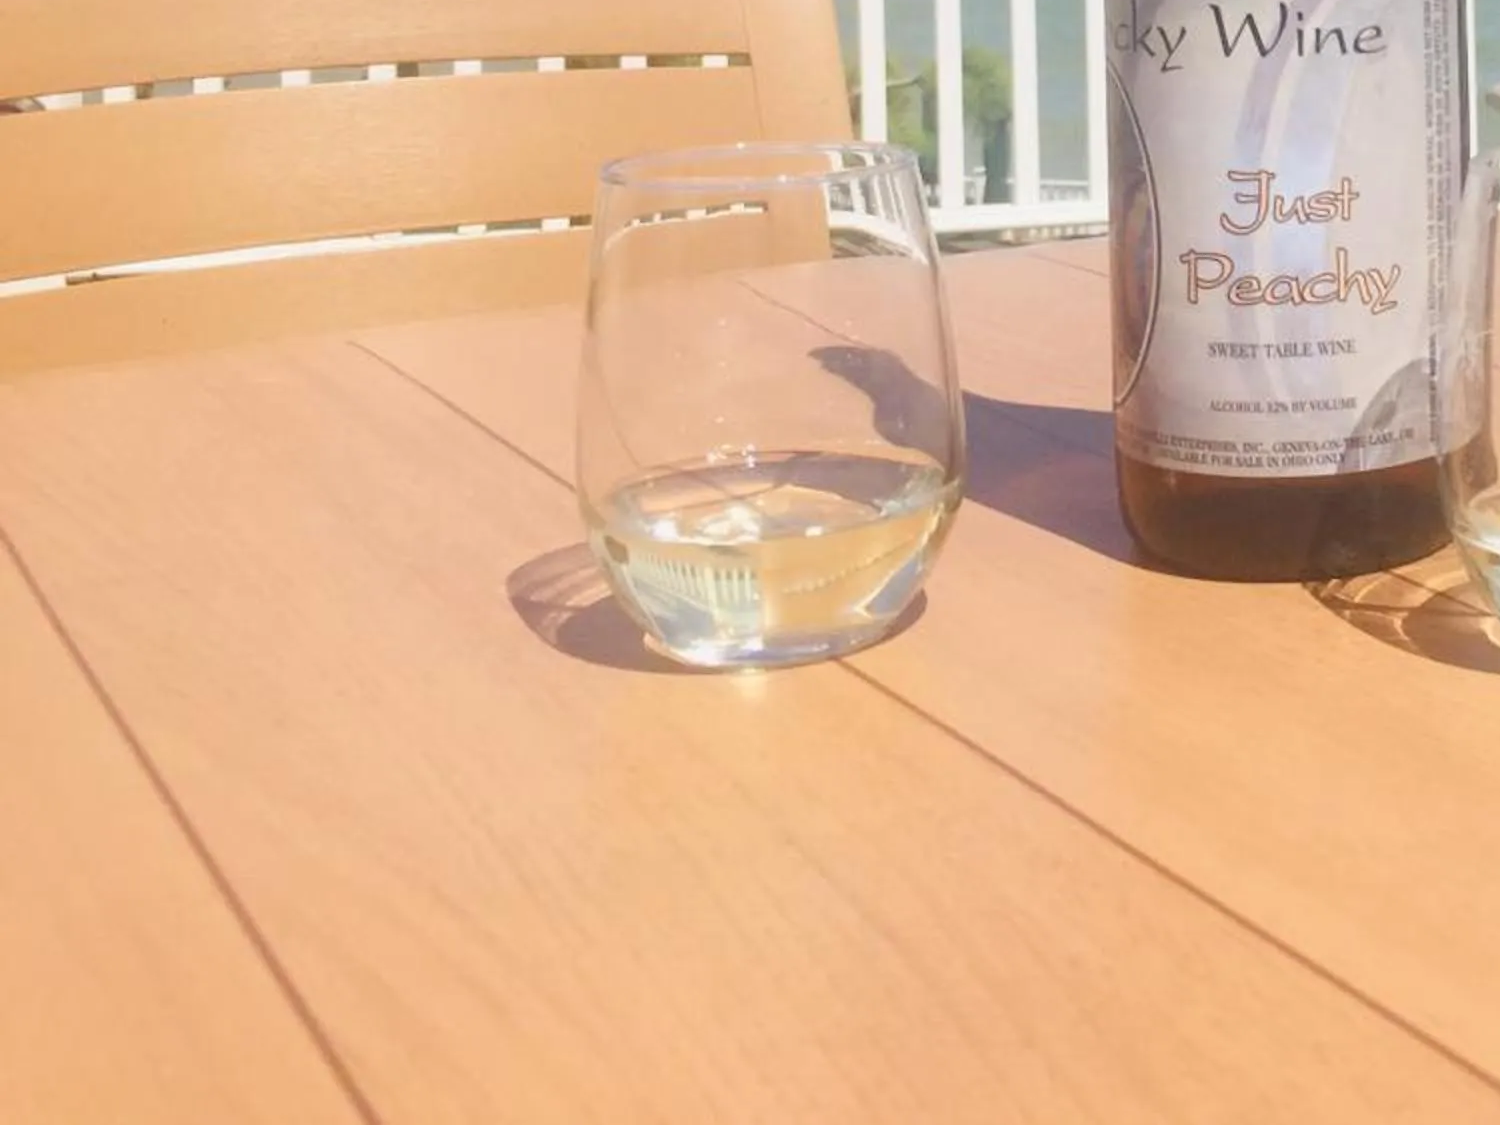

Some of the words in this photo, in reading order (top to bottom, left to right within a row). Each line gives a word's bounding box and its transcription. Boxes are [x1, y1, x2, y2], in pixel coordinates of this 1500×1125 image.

[1209, 2, 1387, 58] Wine
[1219, 170, 1359, 236] Just
[1179, 248, 1400, 314] Peachy
[1207, 342, 1258, 359] SWEET
[1264, 342, 1313, 358] TABLE
[1317, 339, 1356, 356] WINE
[1210, 400, 1264, 413] ALCOHOL
[1307, 397, 1357, 411] VOLUME
[1266, 455, 1280, 468] IN
